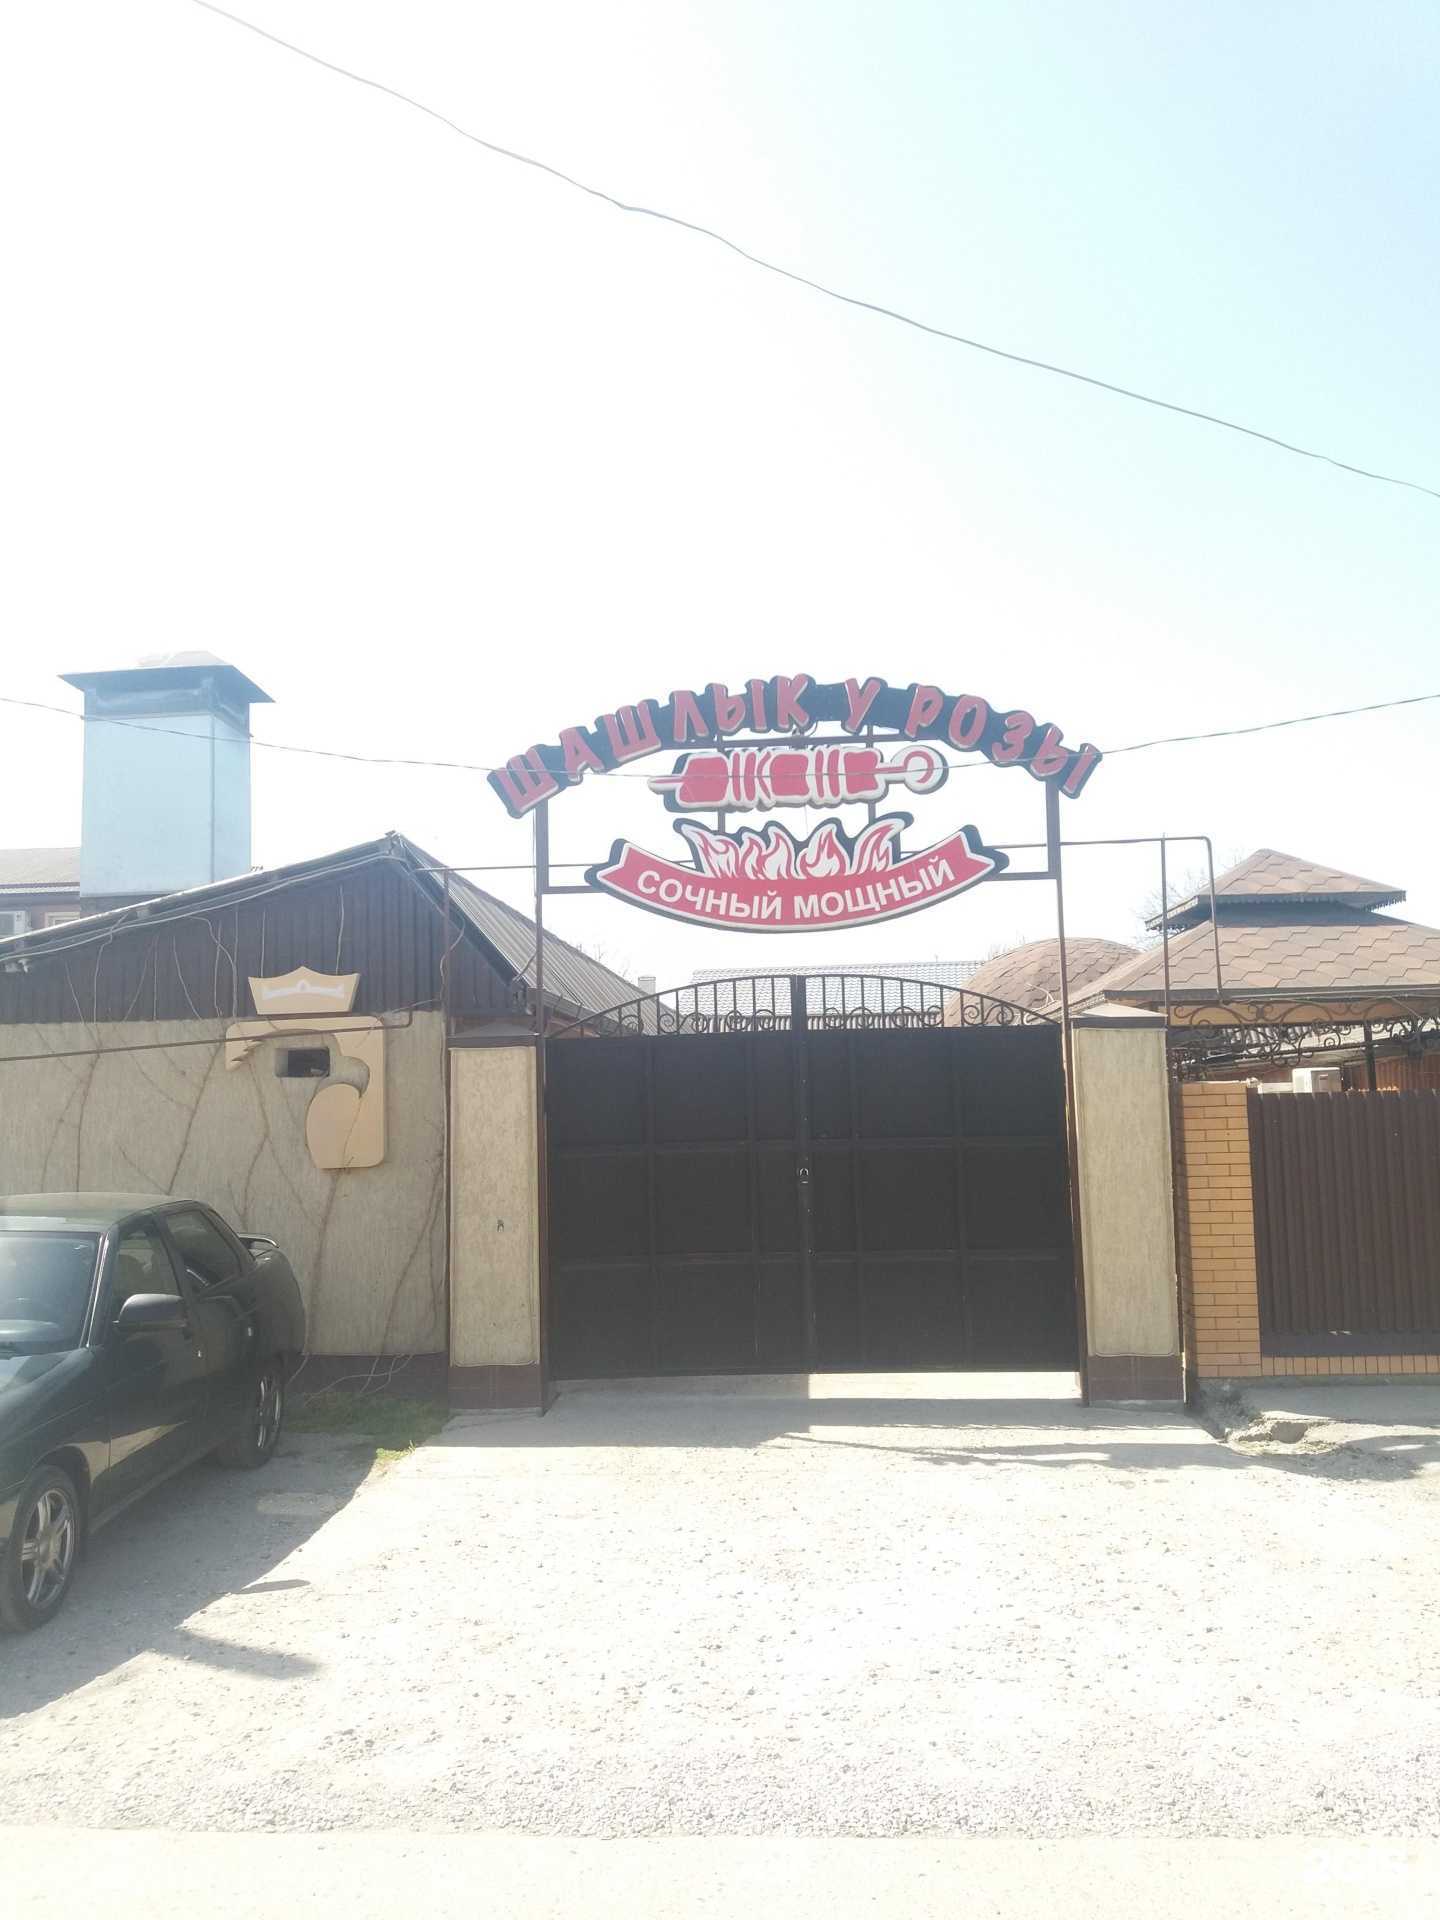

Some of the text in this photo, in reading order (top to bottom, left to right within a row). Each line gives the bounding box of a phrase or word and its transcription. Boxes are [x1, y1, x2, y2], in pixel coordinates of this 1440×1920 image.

[494, 673, 1099, 813] ШАШЛЫК У РОЗЫ
[636, 855, 956, 920] СОЧНЫЙ МОЩНЫЙ
